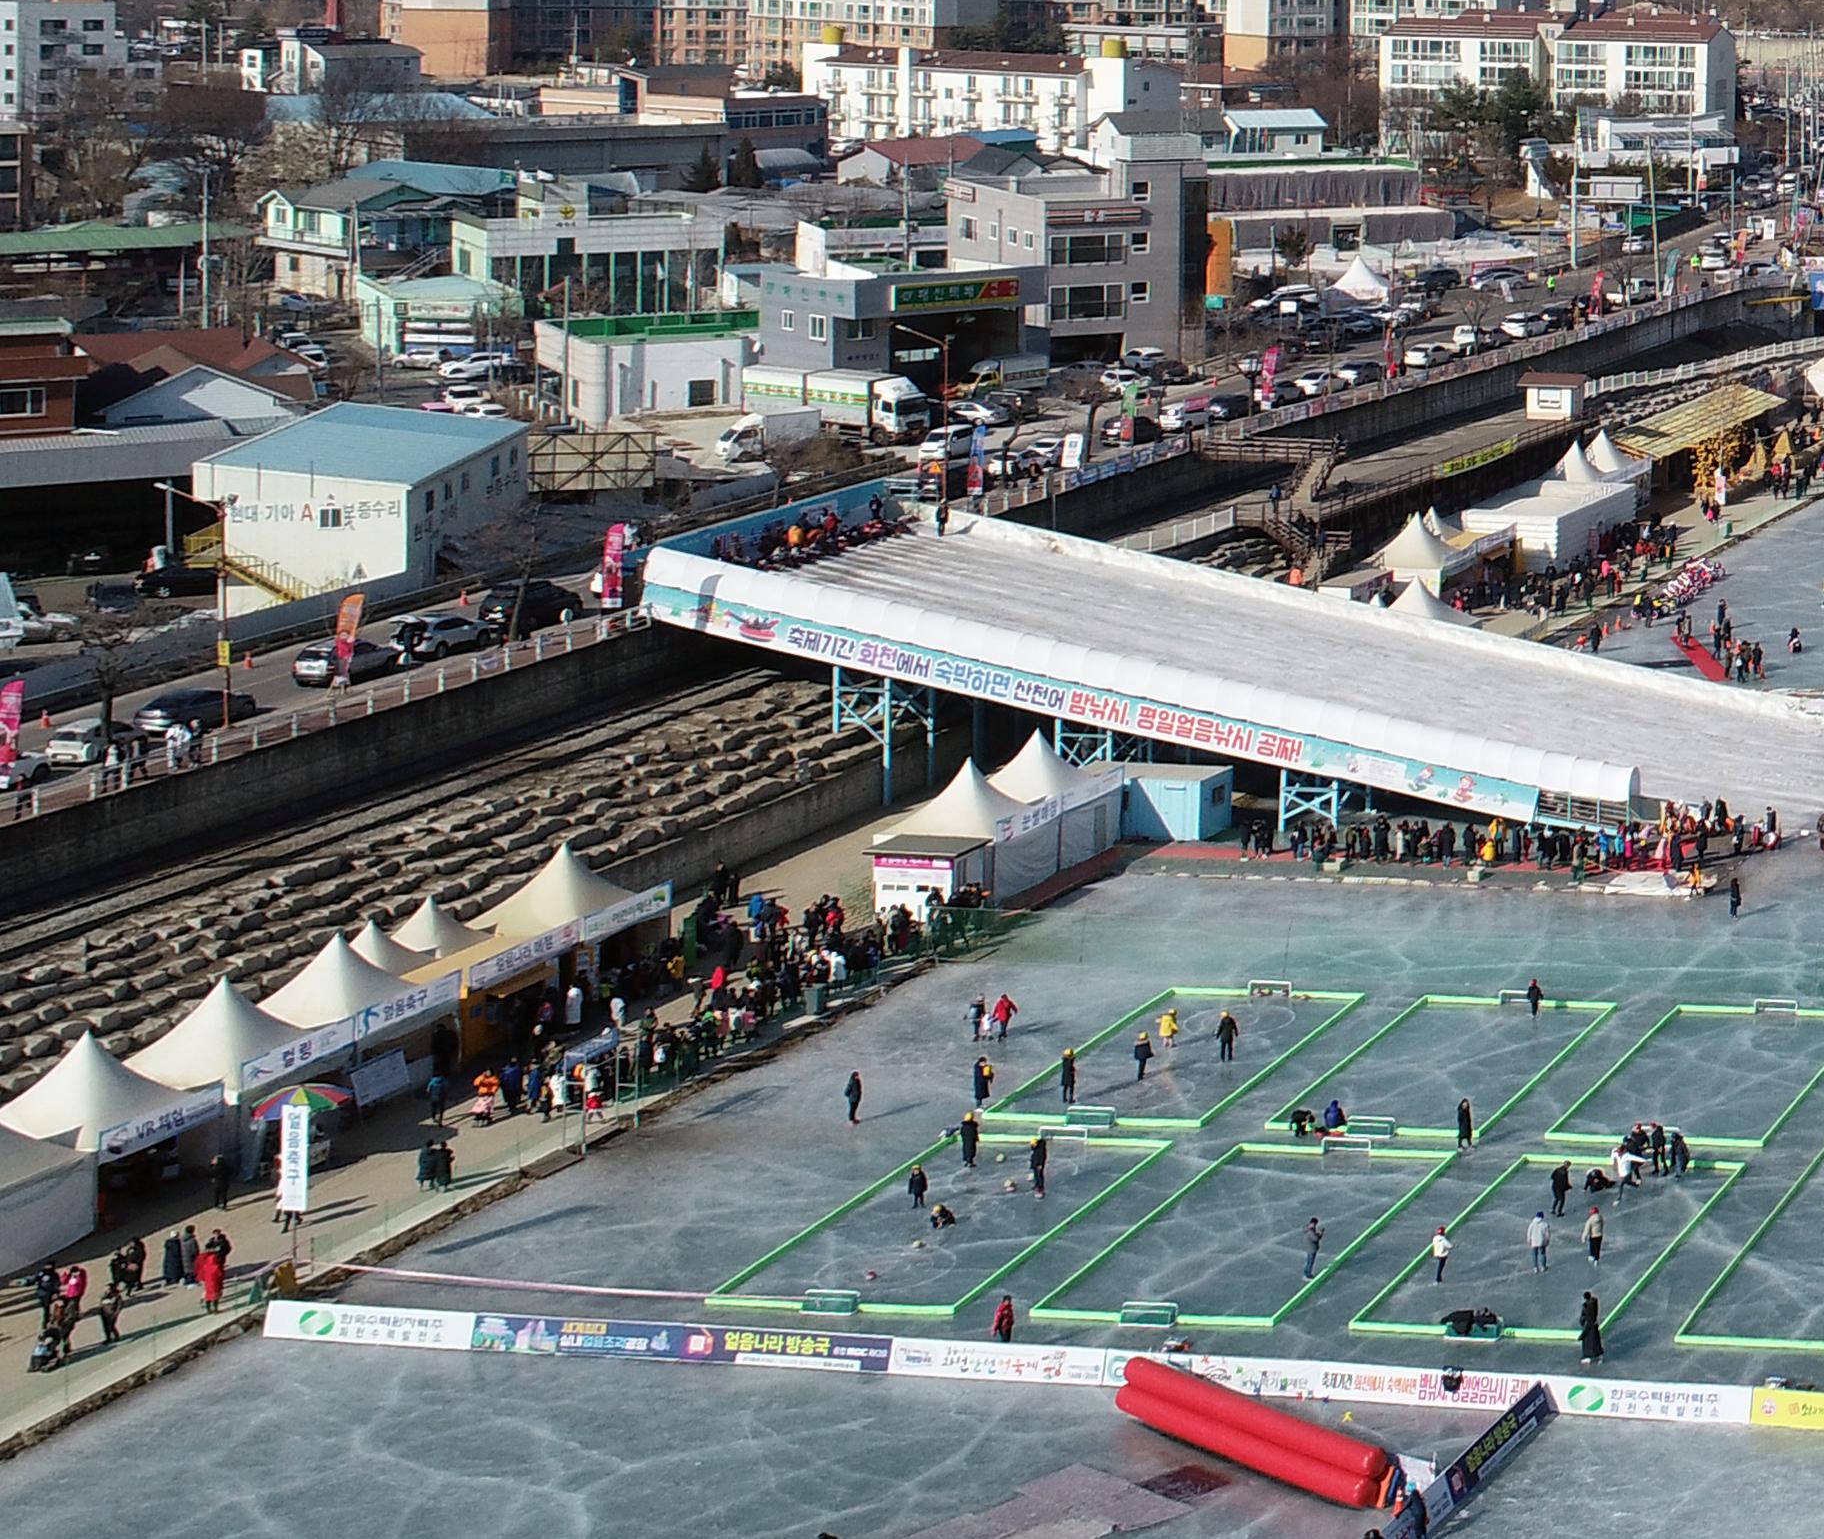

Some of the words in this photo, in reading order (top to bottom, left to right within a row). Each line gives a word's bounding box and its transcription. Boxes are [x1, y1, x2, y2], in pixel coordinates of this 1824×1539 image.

[265, 503, 294, 521] 기아
[787, 626, 855, 660] 축제기간
[858, 641, 932, 678] 화천에서
[934, 659, 1011, 698] 숙박하면
[1014, 681, 1066, 711] 산천어
[1069, 690, 1130, 726] 밤낚시,
[1136, 705, 1253, 752] 평일얼음낚시
[1256, 732, 1304, 762] 공짜!
[136, 1119, 156, 1139] VR
[723, 1331, 784, 1354] 얼음나라
[785, 1335, 832, 1357] 방송국
[1322, 1371, 1353, 1390] 축제기간
[1354, 1373, 1386, 1391] 화천에서
[1387, 1376, 1418, 1395] 숙박하면
